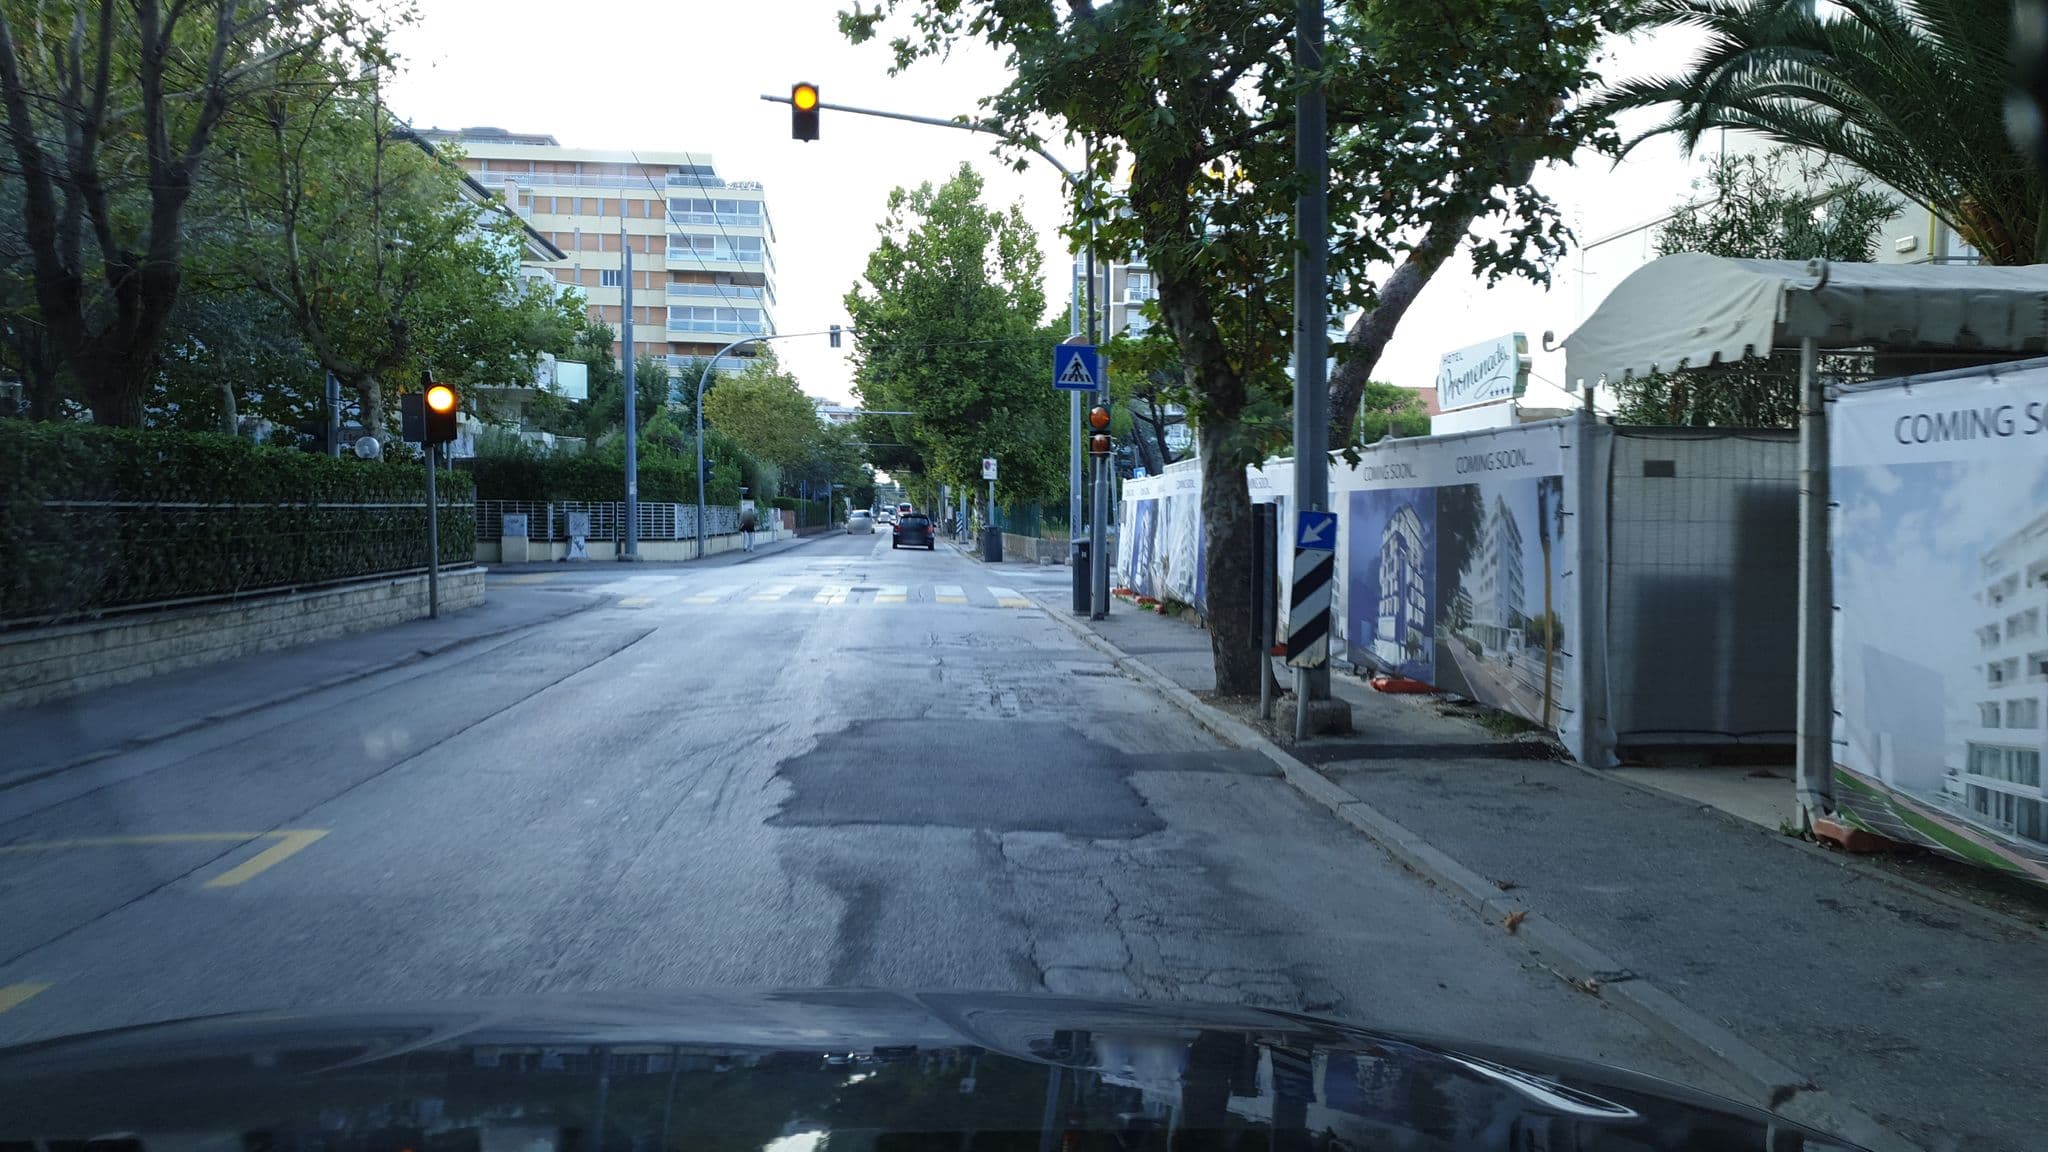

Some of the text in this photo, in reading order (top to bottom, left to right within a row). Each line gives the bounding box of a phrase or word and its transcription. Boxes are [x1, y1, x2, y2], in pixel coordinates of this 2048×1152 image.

[1443, 352, 1463, 365] HOTEL
[1894, 405, 2016, 445] COMING
[1456, 453, 1494, 474] COMING
